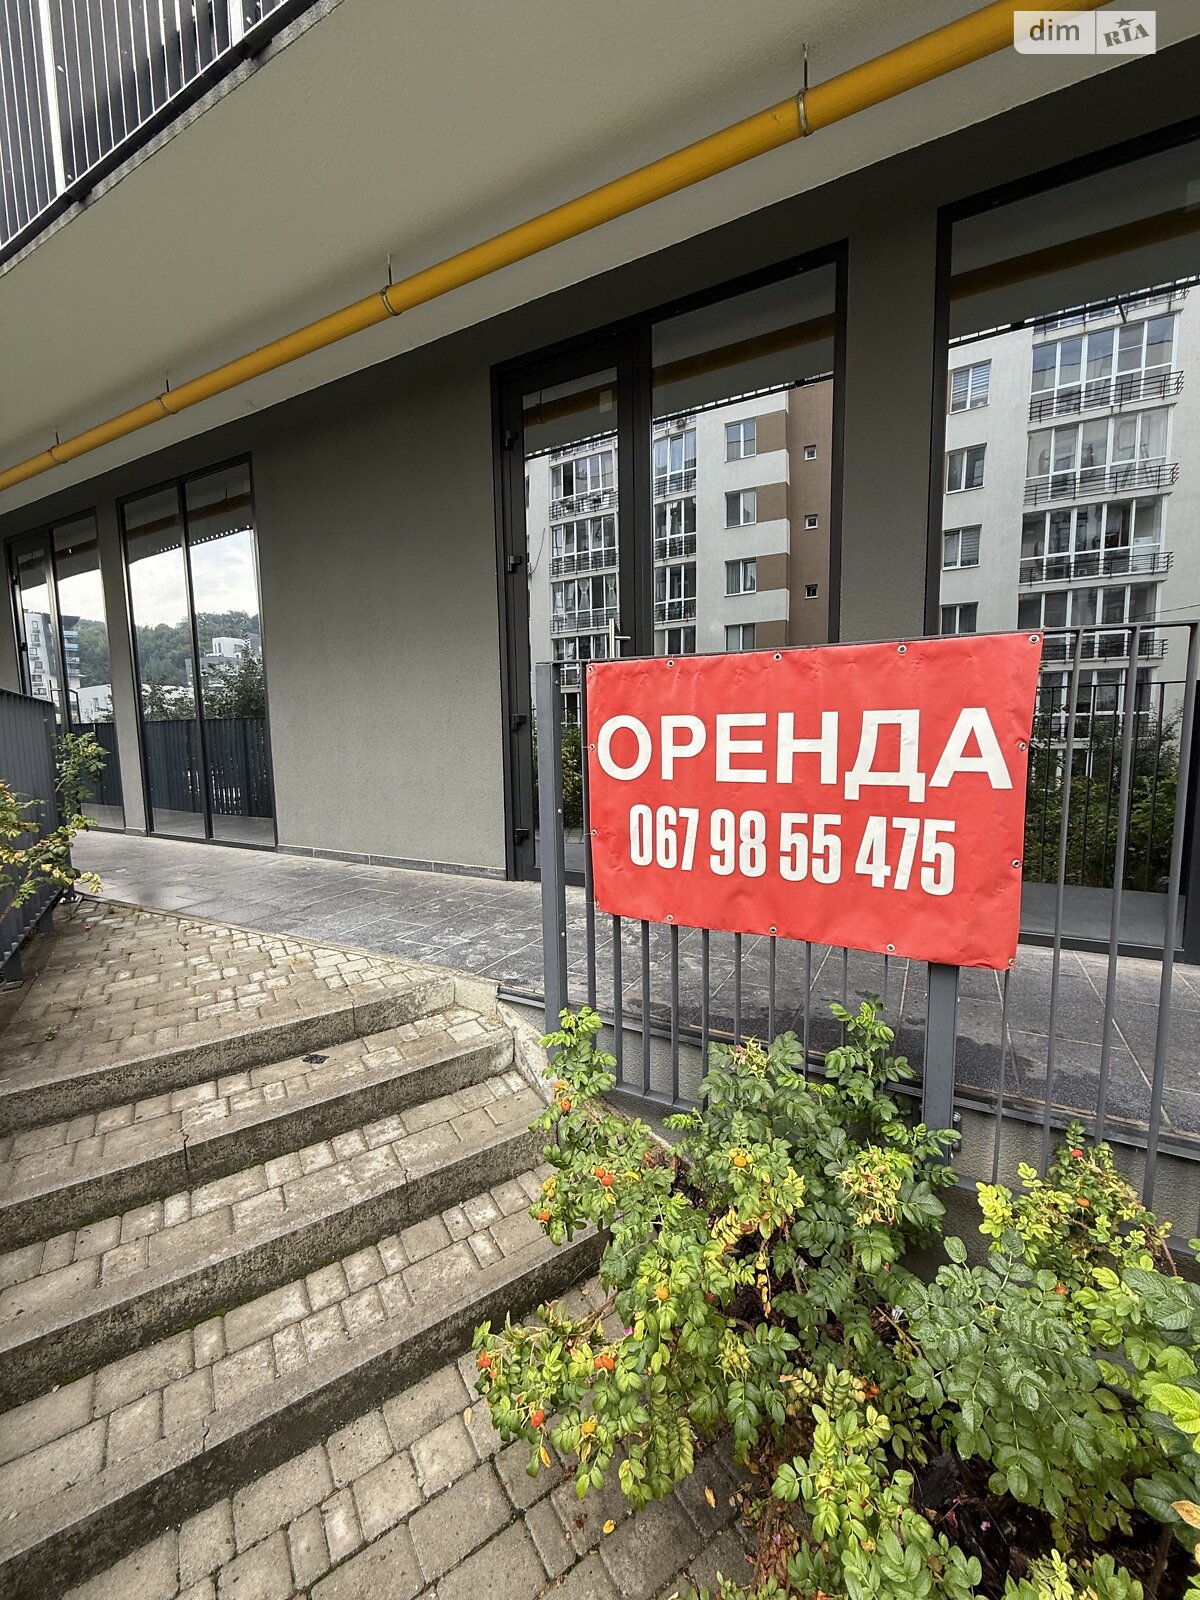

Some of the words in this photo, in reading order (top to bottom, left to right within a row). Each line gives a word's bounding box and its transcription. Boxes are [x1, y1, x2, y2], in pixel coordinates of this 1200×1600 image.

[597, 707, 1014, 803] ОРЕНДА
[629, 803, 700, 871] 067
[709, 808, 767, 878] 98
[779, 812, 842, 884] 55
[854, 815, 956, 896] 475
